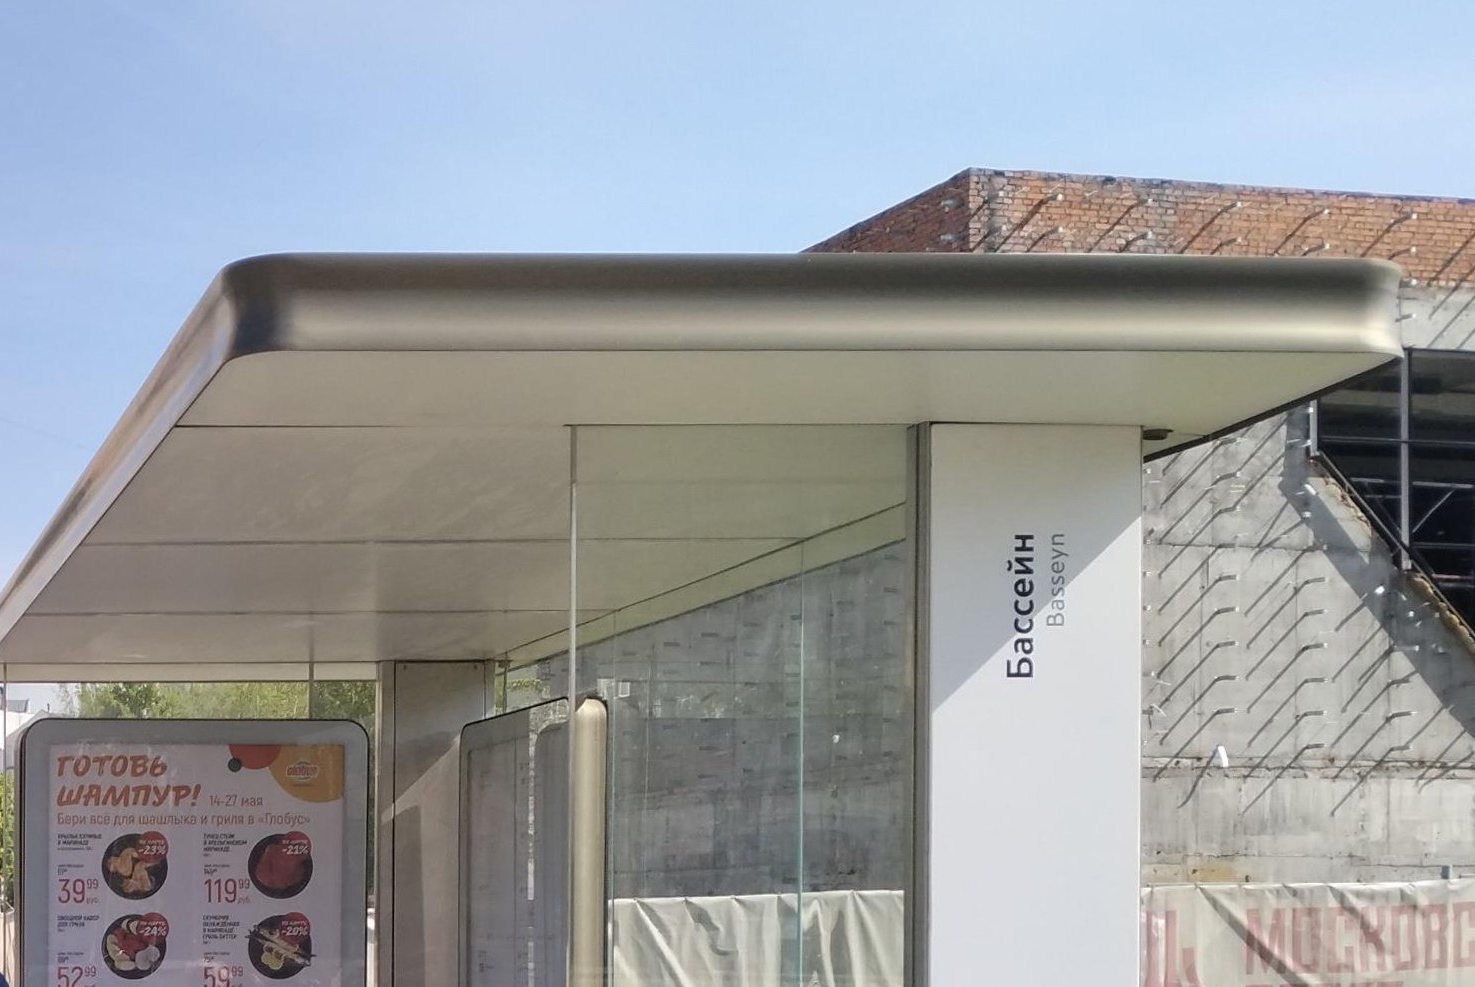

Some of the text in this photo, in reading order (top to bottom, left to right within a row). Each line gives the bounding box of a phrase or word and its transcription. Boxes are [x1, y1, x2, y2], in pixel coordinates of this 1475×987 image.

[1046, 533, 1068, 626] Basseyn
[1006, 534, 1034, 678] Бассейн
[57, 755, 167, 777] ГОТОВЬ
[57, 784, 201, 807] ШАМПУР!
[241, 797, 263, 806] мая
[57, 813, 86, 827] Бери
[114, 815, 134, 826] для
[139, 815, 197, 825] шашлыка
[201, 816, 207, 824] и
[211, 816, 244, 826] гриля
[248, 816, 254, 824] в
[258, 812, 311, 827] «Глобус»
[138, 845, 166, 855] -23%
[282, 845, 309, 855] -21%
[58, 879, 99, 903] 39 99
[204, 878, 250, 903] 119 99
[139, 926, 167, 937] -24%
[282, 927, 308, 937] -20%
[84, 966, 97, 977] 99
[232, 966, 244, 977] 99
